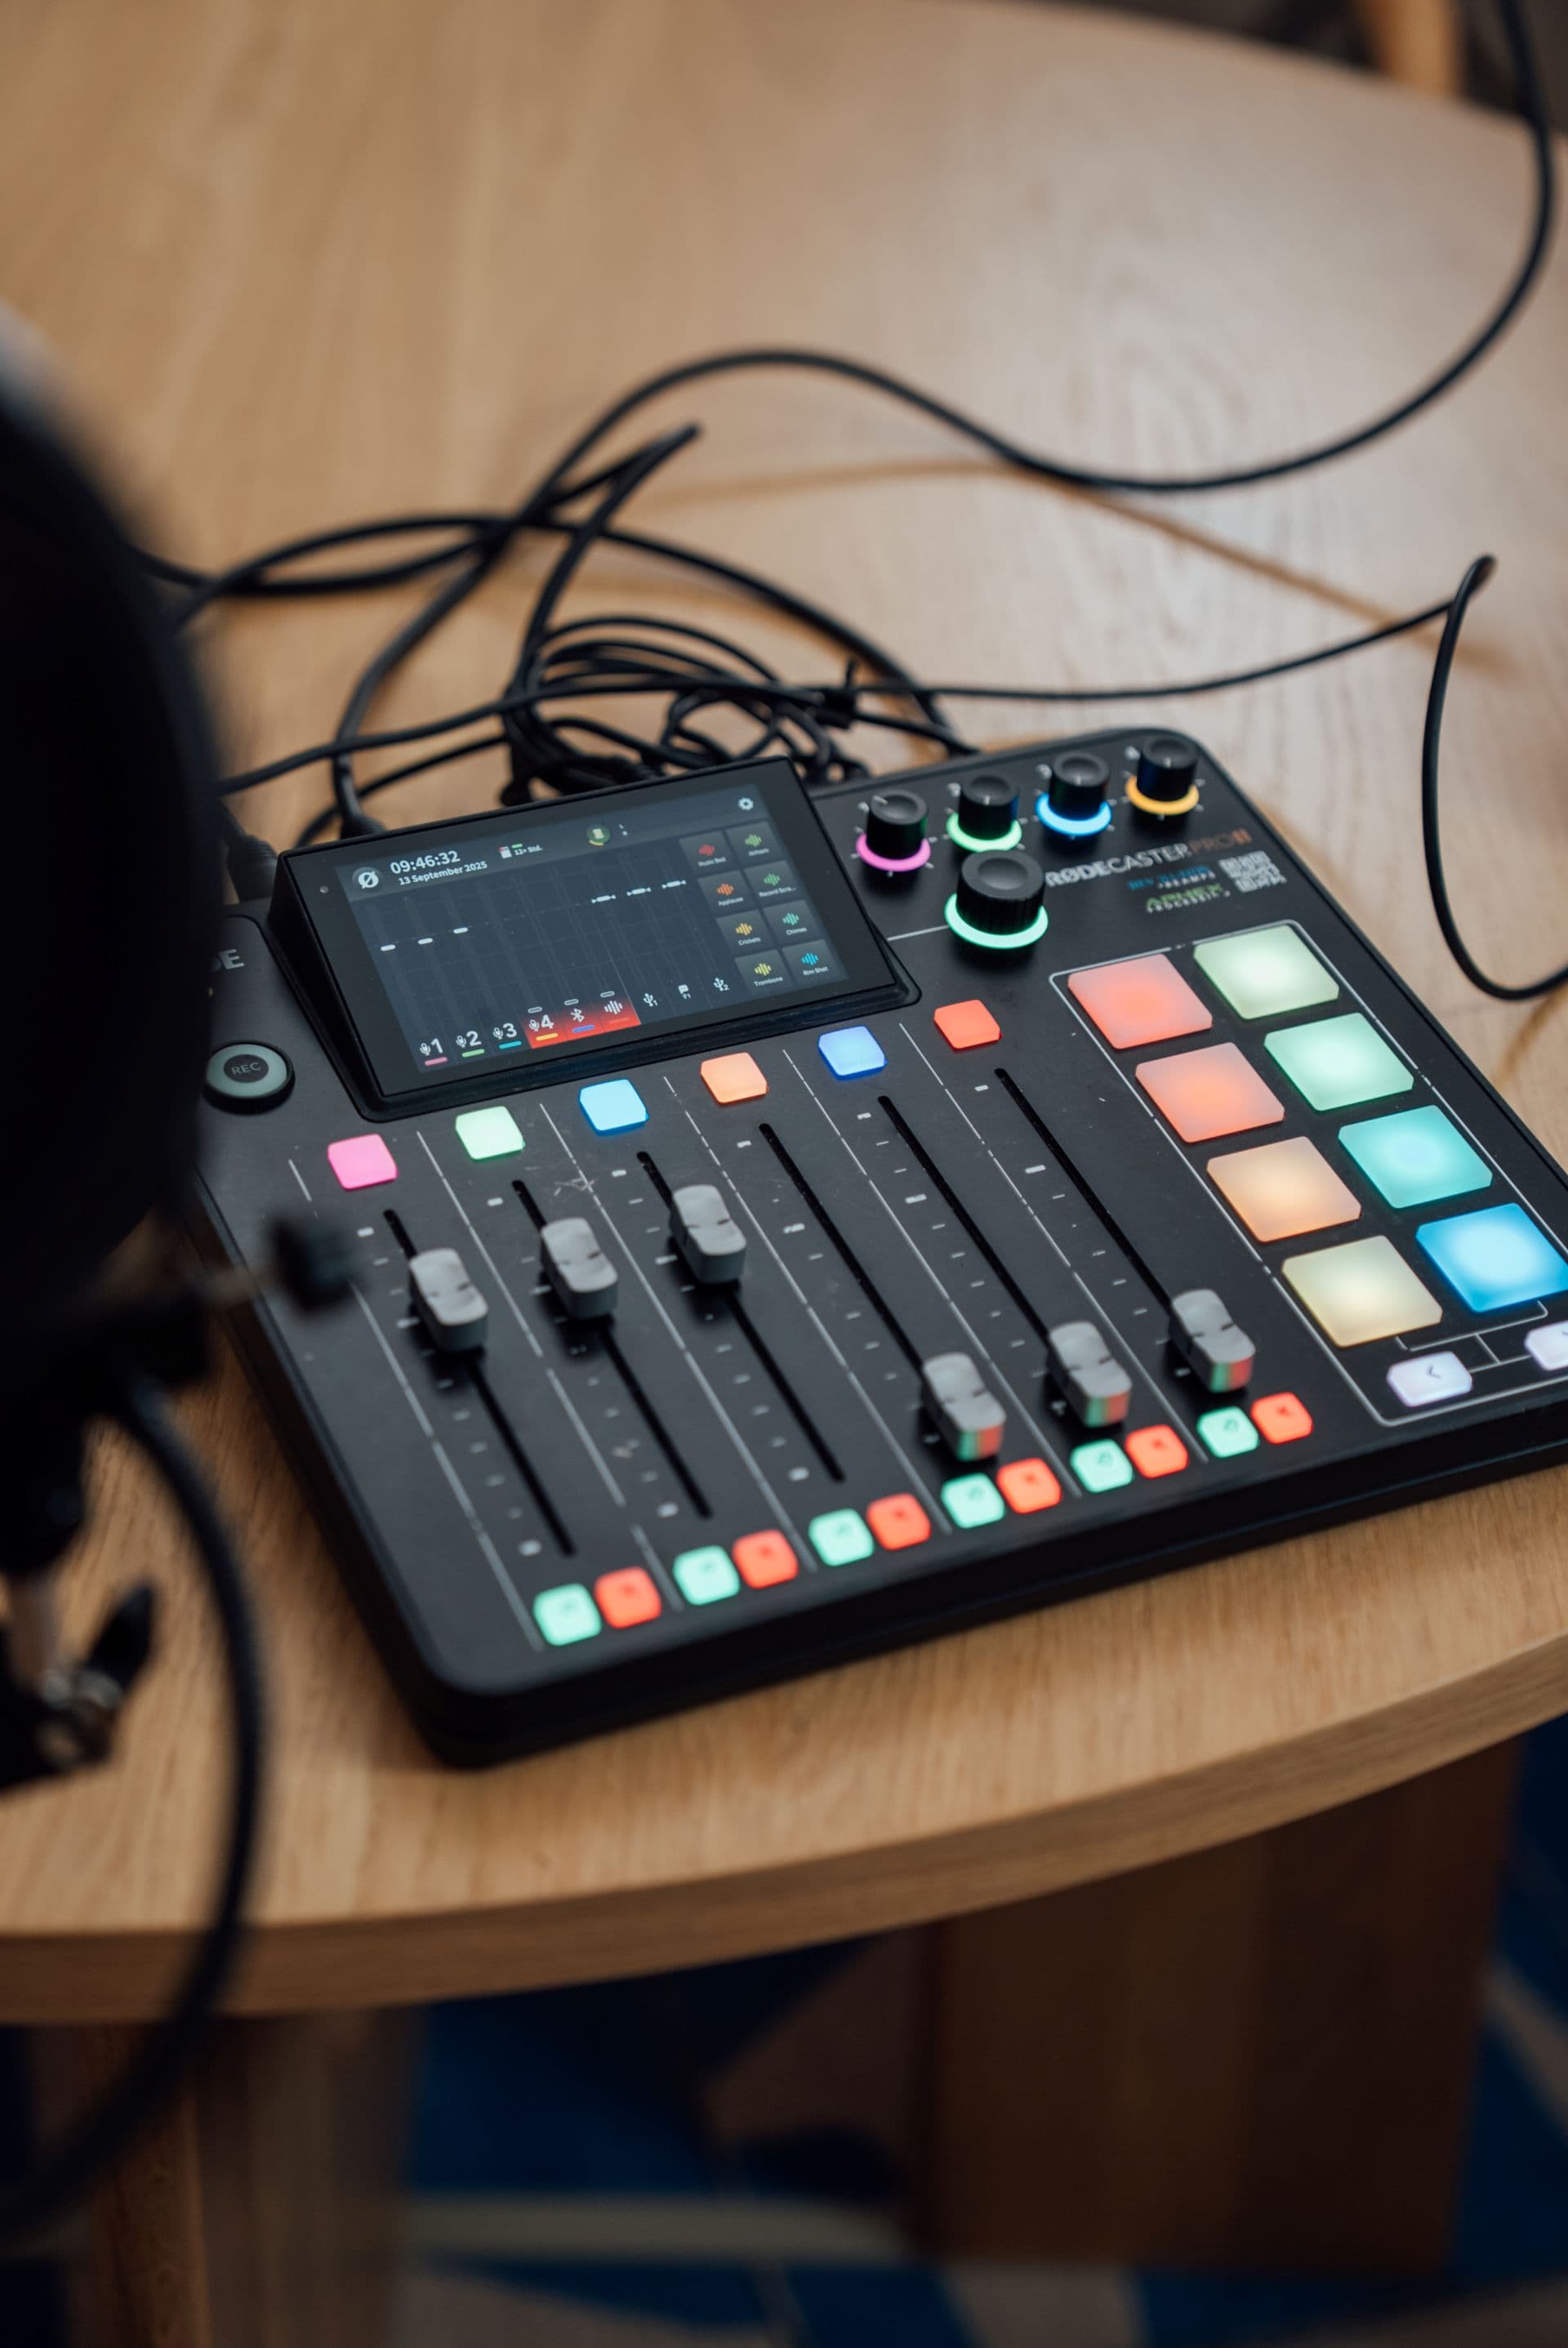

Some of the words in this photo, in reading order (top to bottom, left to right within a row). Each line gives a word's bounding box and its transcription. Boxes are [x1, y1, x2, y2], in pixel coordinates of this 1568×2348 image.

[390, 850, 461, 874] 09:46:32
[399, 875, 411, 885] 13
[412, 867, 463, 884] September
[464, 861, 488, 873] 2025
[541, 1014, 555, 1029] 4
[502, 1023, 517, 1038] 3
[431, 1038, 443, 1054] 1
[466, 1031, 482, 1046] 2
[231, 1062, 261, 1076] REC
